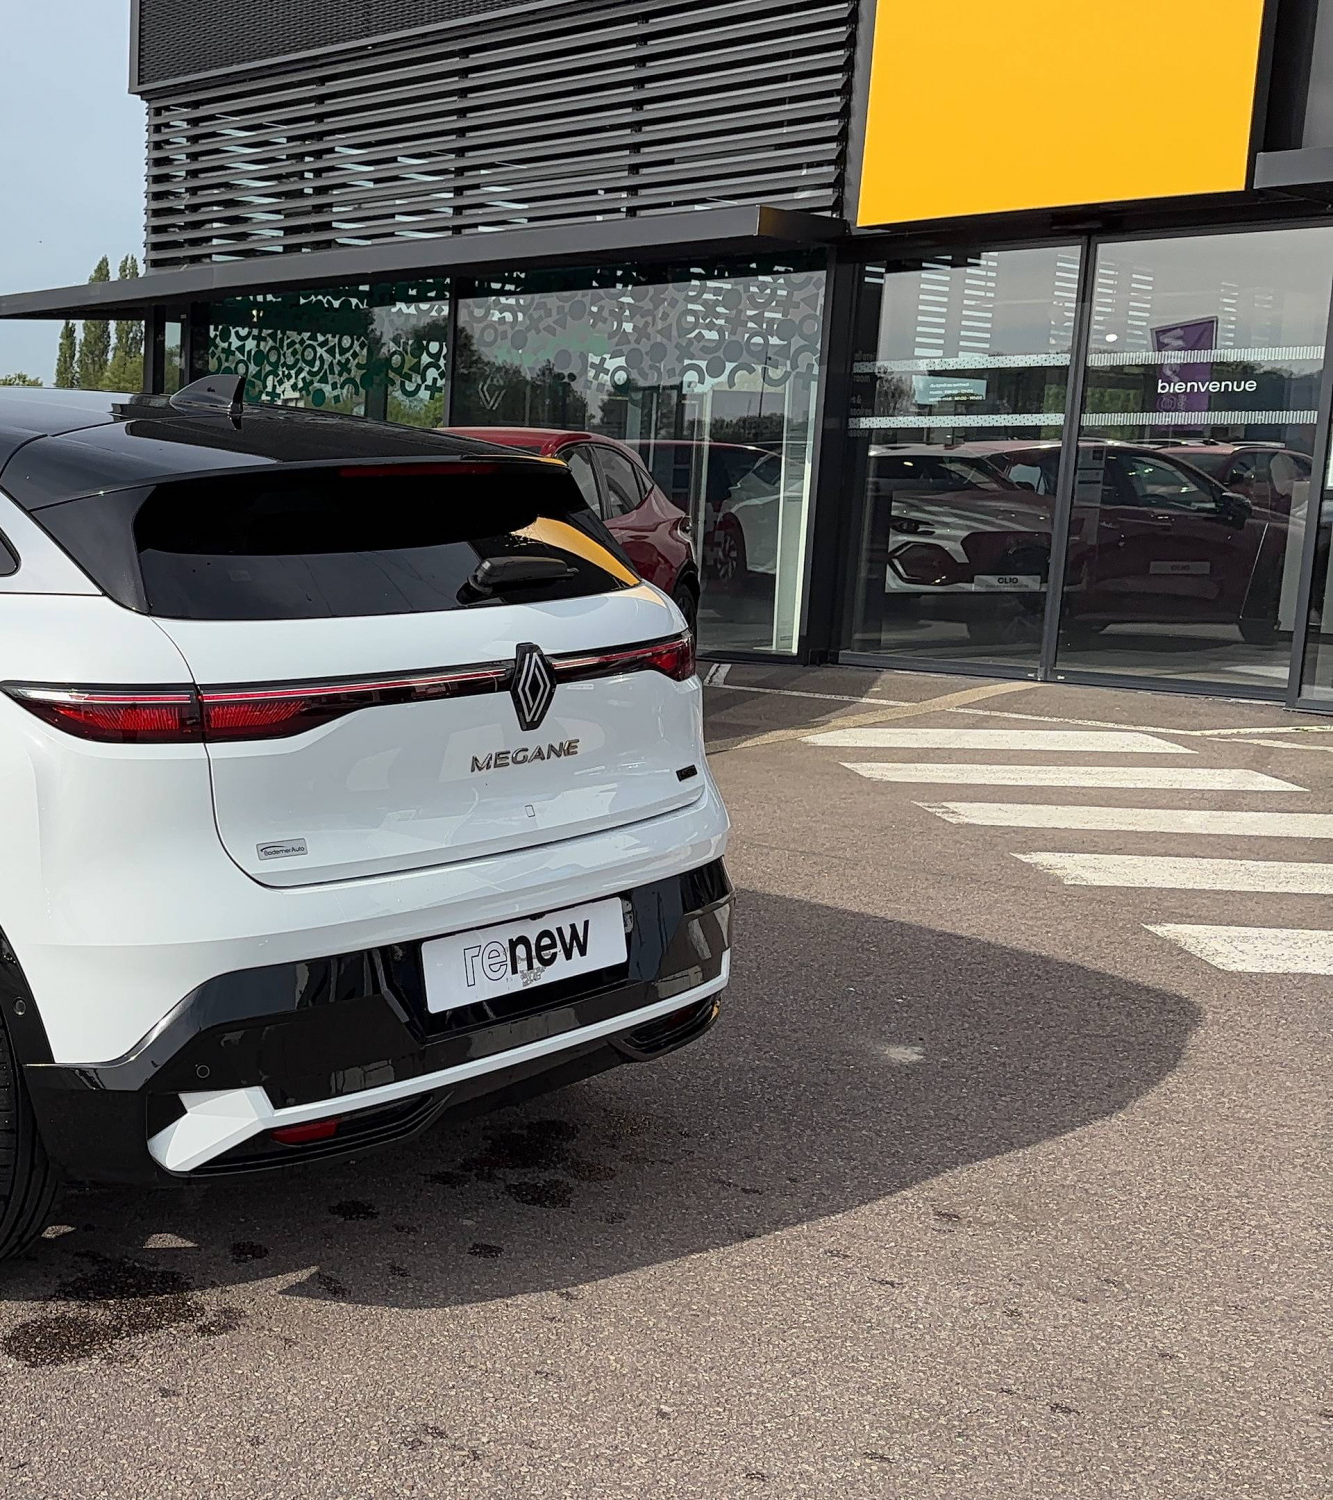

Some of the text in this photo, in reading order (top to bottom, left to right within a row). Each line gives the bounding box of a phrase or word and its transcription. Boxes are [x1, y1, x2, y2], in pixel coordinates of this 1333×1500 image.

[1157, 379, 1258, 394] bienvenue
[470, 739, 580, 773] MEGANE
[463, 919, 590, 987] renew
